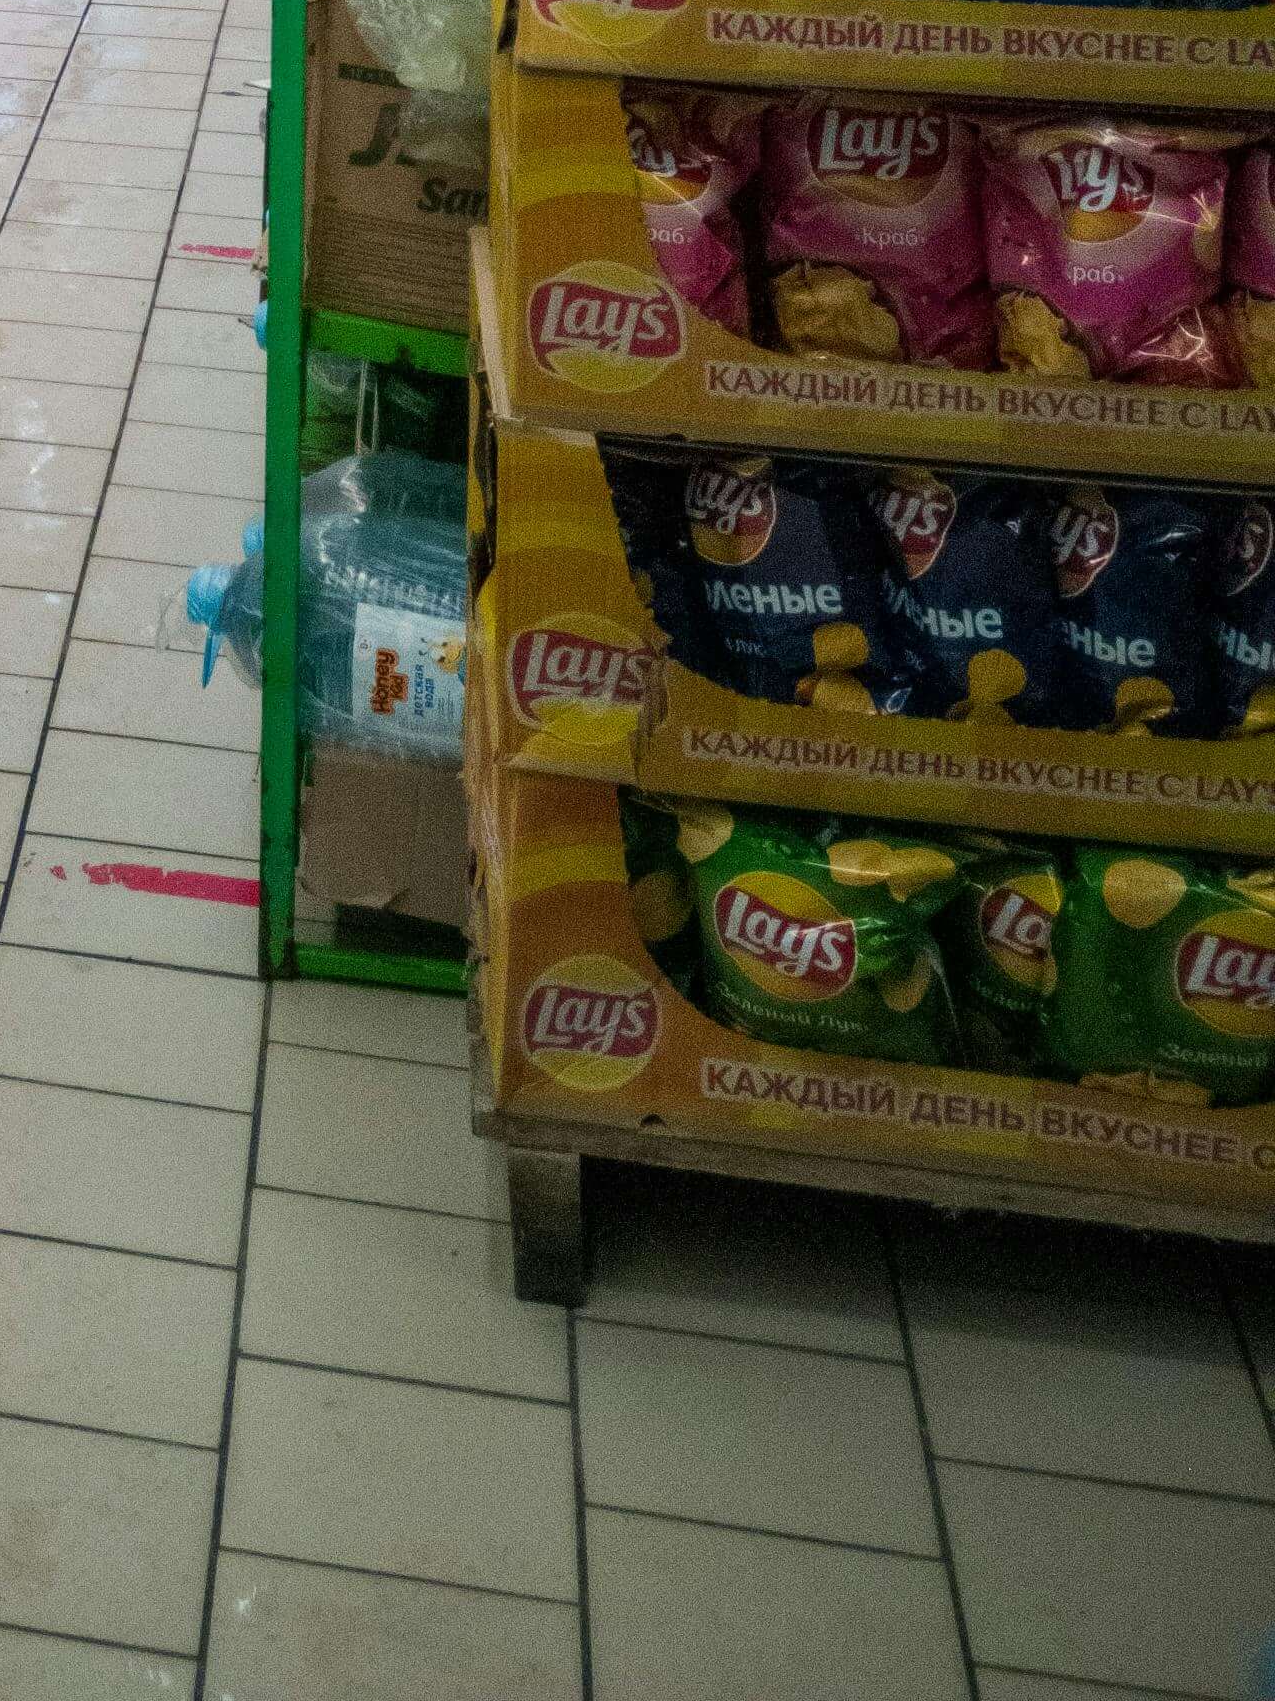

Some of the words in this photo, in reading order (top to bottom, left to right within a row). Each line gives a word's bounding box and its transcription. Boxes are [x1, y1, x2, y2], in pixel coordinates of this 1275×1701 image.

[710, 10, 885, 53] КАЖДЫЙ
[892, 21, 994, 59] ДЕНЬ
[1002, 28, 1175, 64] ВКУСНЕЕ
[819, 111, 942, 177] Lay's
[544, 283, 673, 361] Lay's
[706, 363, 878, 406] КАЖДЫЙ
[886, 376, 987, 414] ДЕНЬ
[996, 385, 1167, 428] ВКУСНЕЕ
[690, 726, 859, 771] КАЖДЫЙ
[868, 746, 967, 781] ДЕНЬ
[976, 755, 1146, 795] ВКУСНЕЕ
[725, 890, 847, 979] Lay's
[531, 991, 650, 1060] Lay's
[704, 1060, 898, 1115] КАЖДЫЙ
[910, 1092, 1029, 1137] ДЕНЬ
[1040, 1109, 1235, 1168] ВКУСНЕЕ
